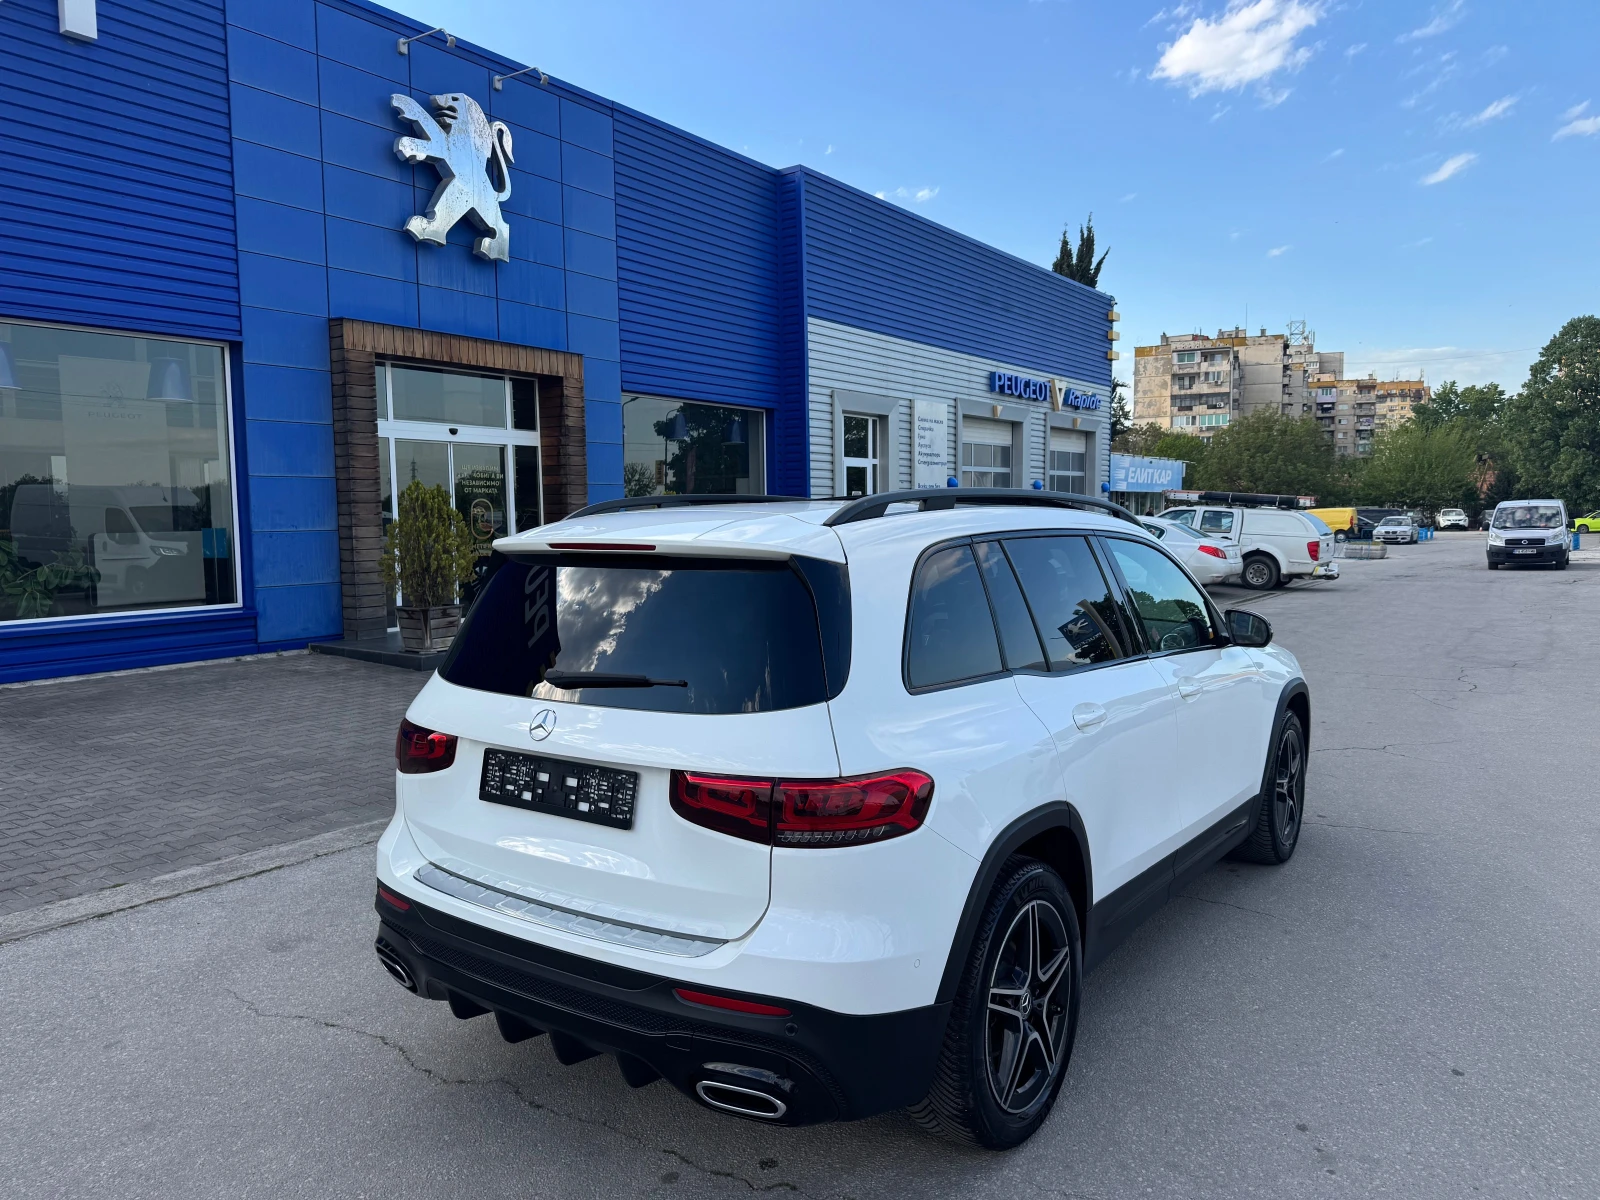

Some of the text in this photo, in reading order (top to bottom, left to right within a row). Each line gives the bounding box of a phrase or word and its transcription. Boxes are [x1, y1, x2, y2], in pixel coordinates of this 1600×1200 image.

[993, 371, 1101, 410] PEUGEOT Rapide
[88, 411, 142, 419] PEUGEOT
[1128, 467, 1172, 484] ЕЛИТКАР
